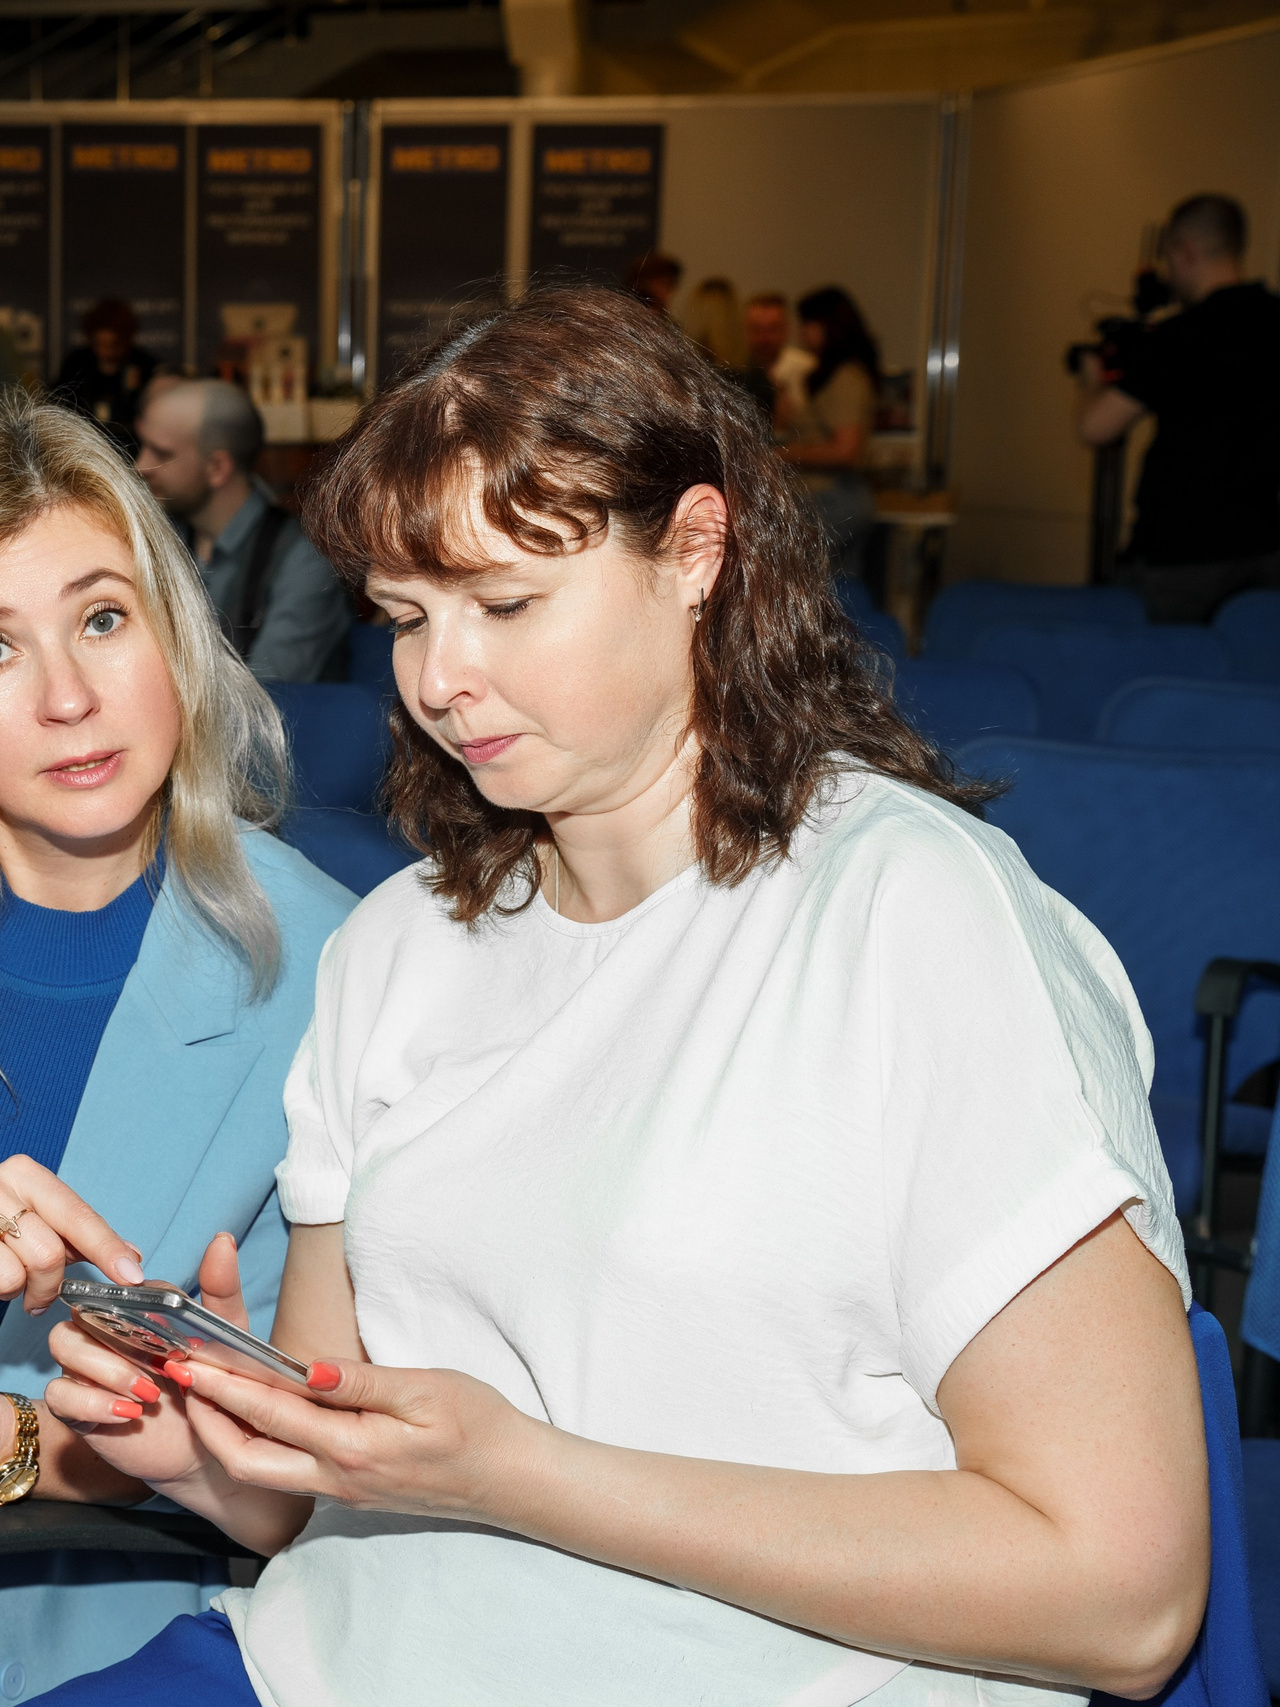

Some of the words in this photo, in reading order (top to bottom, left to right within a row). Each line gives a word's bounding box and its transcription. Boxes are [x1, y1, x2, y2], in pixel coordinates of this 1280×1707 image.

[73, 146, 177, 169] METRO
[208, 149, 312, 172] METRO
[392, 147, 499, 171] METRO
[545, 149, 651, 173] METRO
